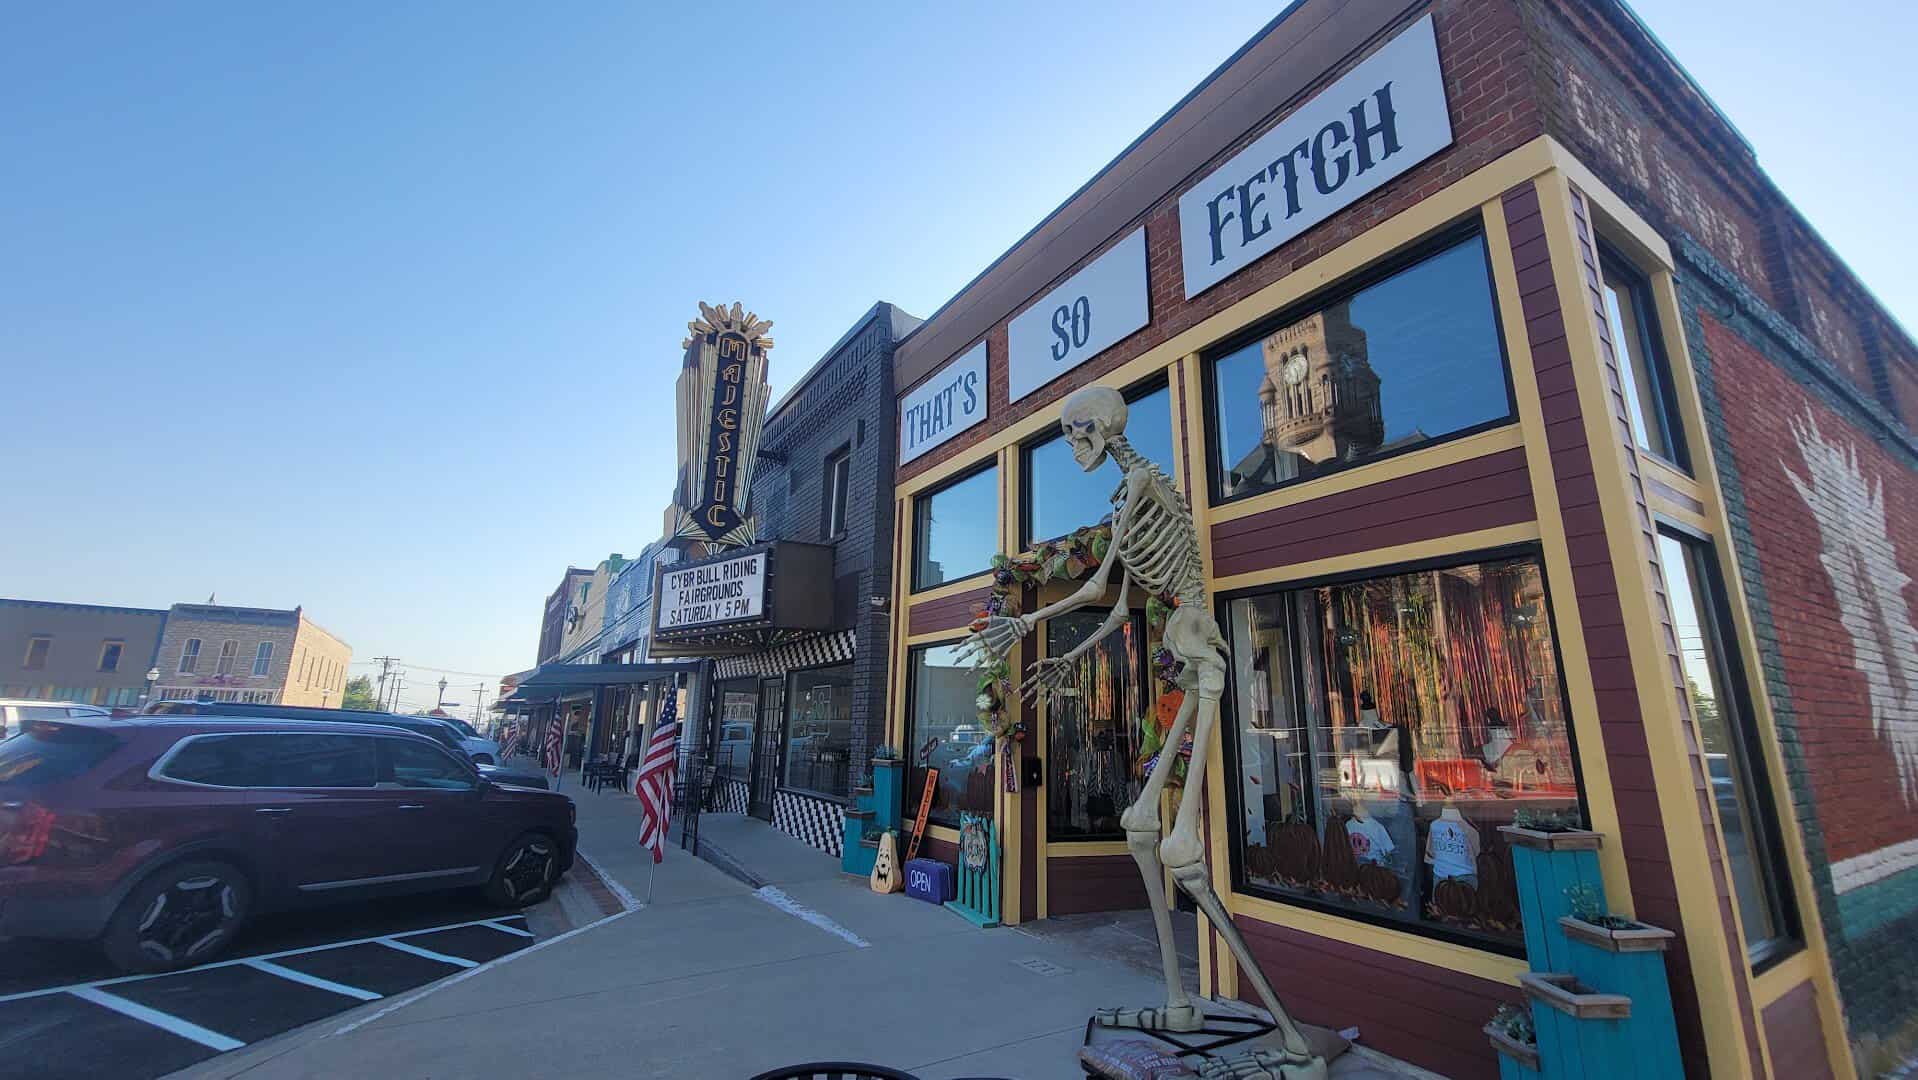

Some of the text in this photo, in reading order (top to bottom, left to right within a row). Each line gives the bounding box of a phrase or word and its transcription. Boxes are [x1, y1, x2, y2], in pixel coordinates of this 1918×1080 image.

[1206, 81, 1403, 266] FETCH
[1051, 295, 1091, 361] SO
[707, 337, 746, 527] MAJESTIC
[906, 369, 978, 450] THAT'S
[671, 558, 757, 590] CYBR BULL RIDING
[678, 580, 744, 606] FAIRGROUNDS
[670, 599, 751, 625] SATURDAY 5 PM
[910, 869, 931, 893] OPEN
